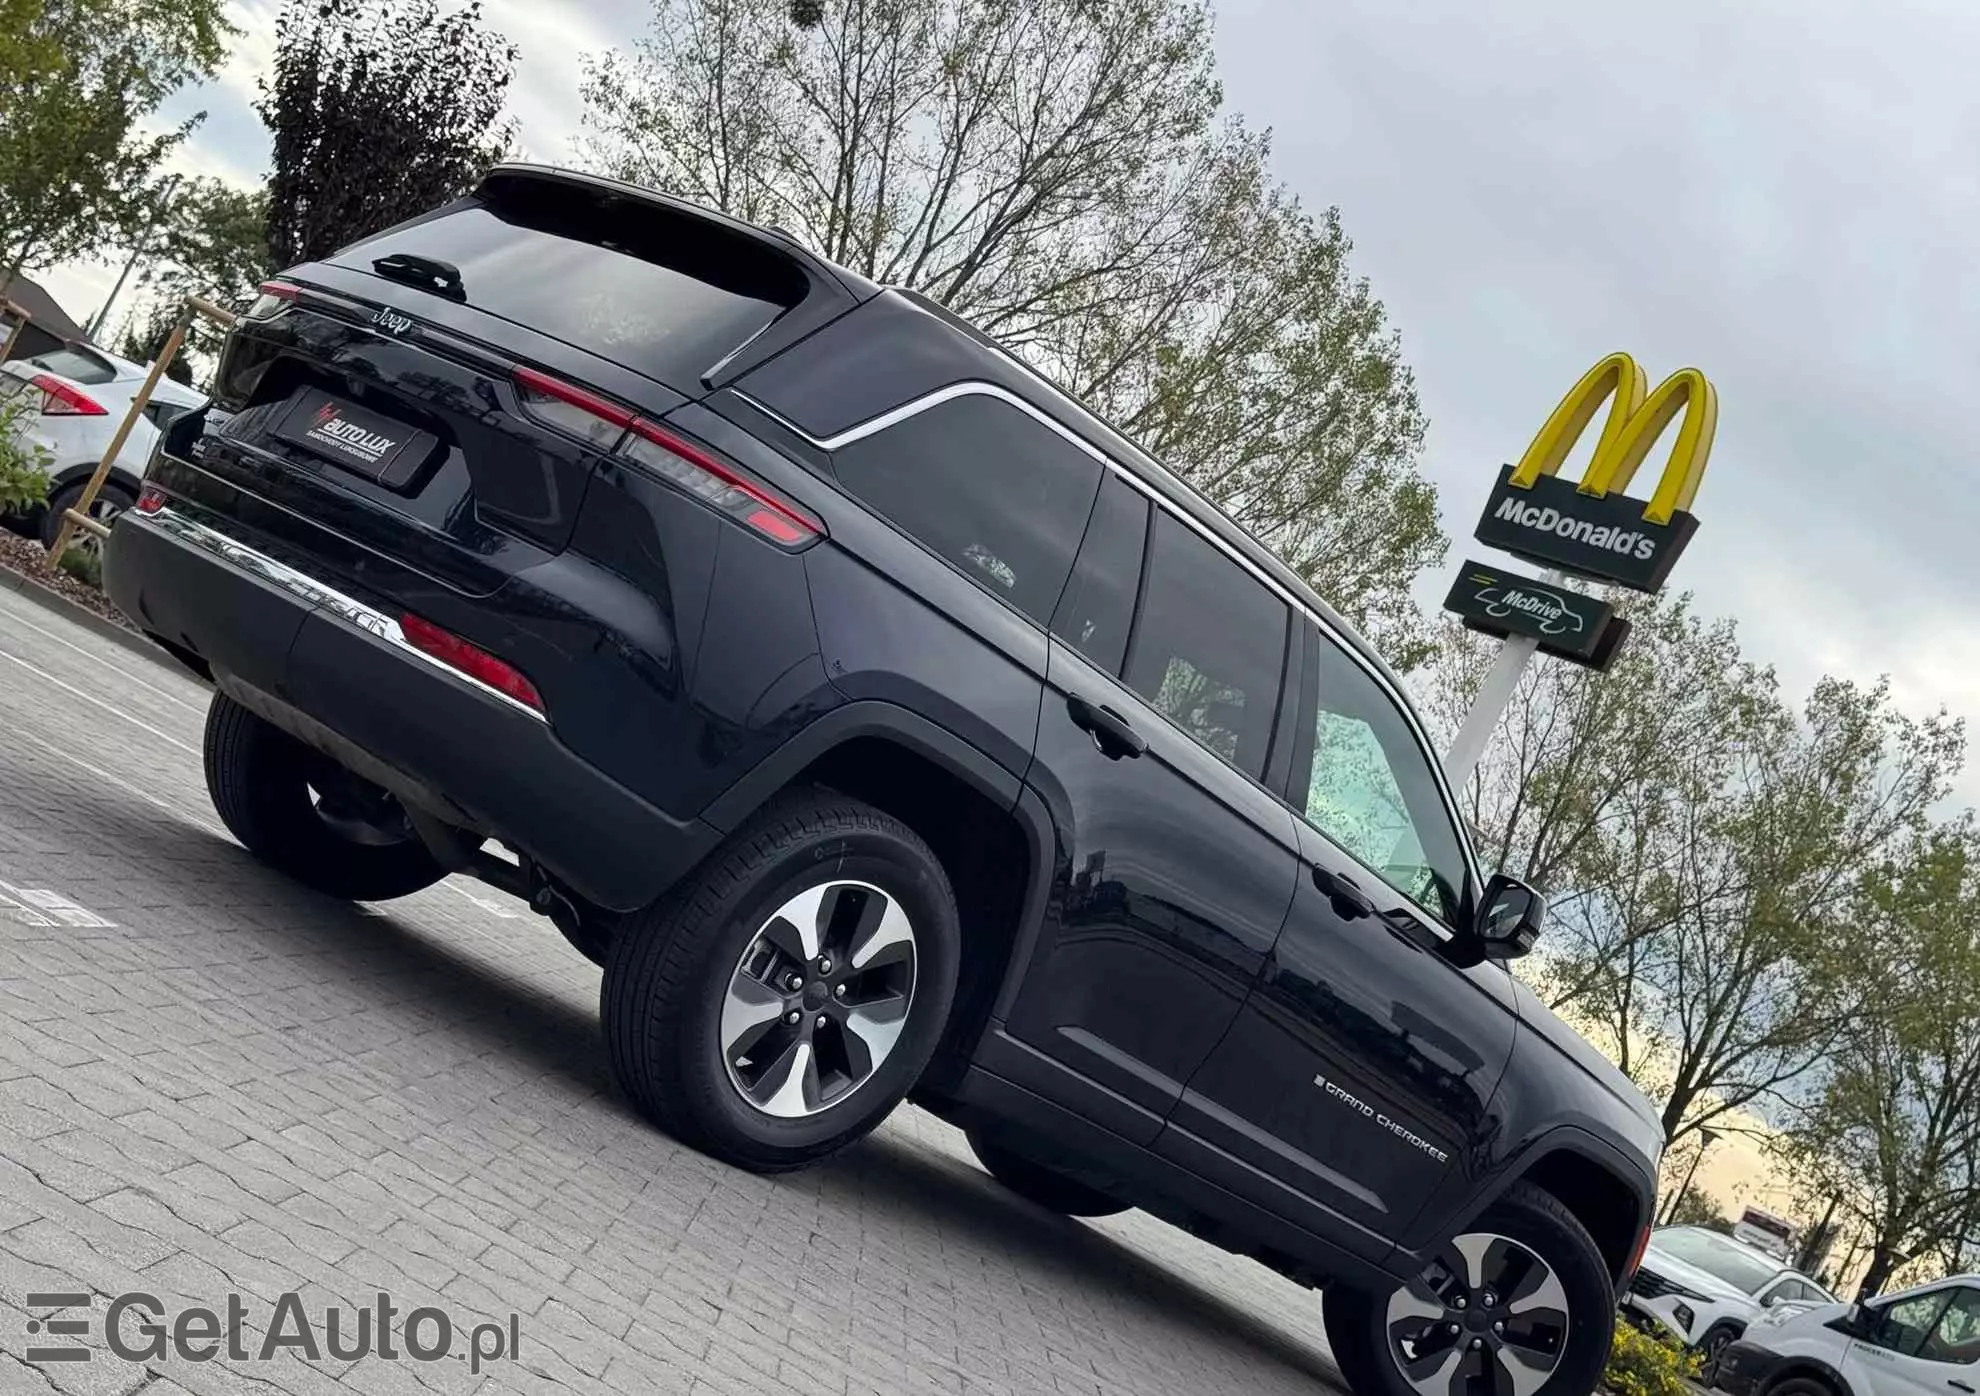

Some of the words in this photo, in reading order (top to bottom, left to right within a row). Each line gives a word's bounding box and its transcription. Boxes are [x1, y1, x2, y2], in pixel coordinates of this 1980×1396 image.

[371, 307, 411, 335] Jeep
[359, 432, 396, 454] LUX
[1495, 497, 1656, 560] McDonald's
[1501, 590, 1562, 620] McDrive
[1325, 1081, 1374, 1117] GRAND
[1376, 1113, 1449, 1162] CHEROKEE
